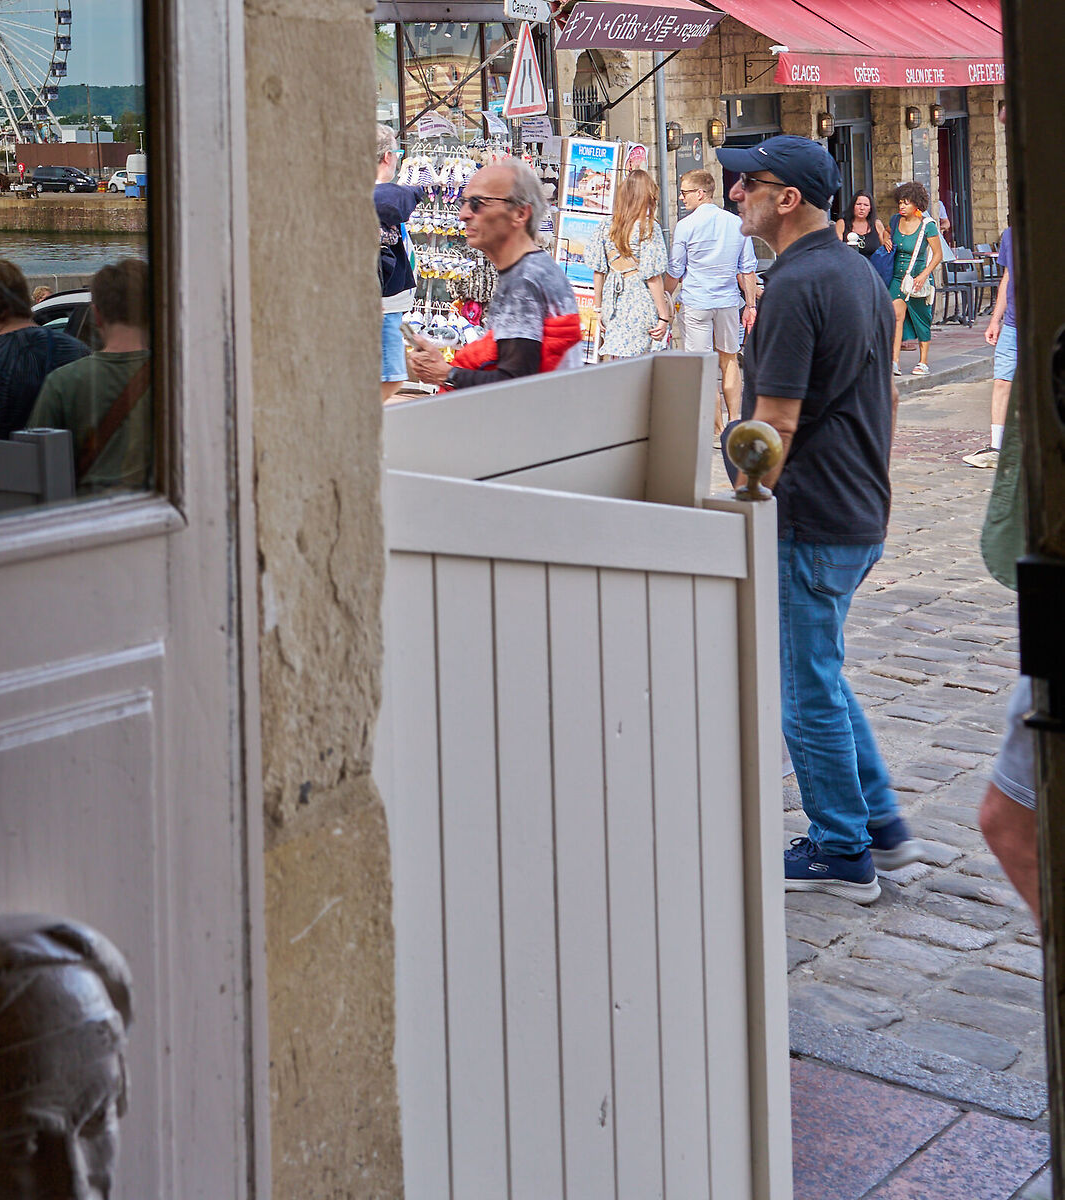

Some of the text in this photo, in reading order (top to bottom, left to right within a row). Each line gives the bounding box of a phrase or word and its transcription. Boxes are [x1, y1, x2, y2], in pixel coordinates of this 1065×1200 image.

[513, 0, 538, 19] Camping
[565, 10, 605, 41] ギフト
[607, 13, 642, 41] Gifts
[644, 14, 678, 42] 선물
[791, 64, 821, 82] GLACES
[905, 68, 924, 84] SALON
[578, 145, 607, 158] HONFLEUR
